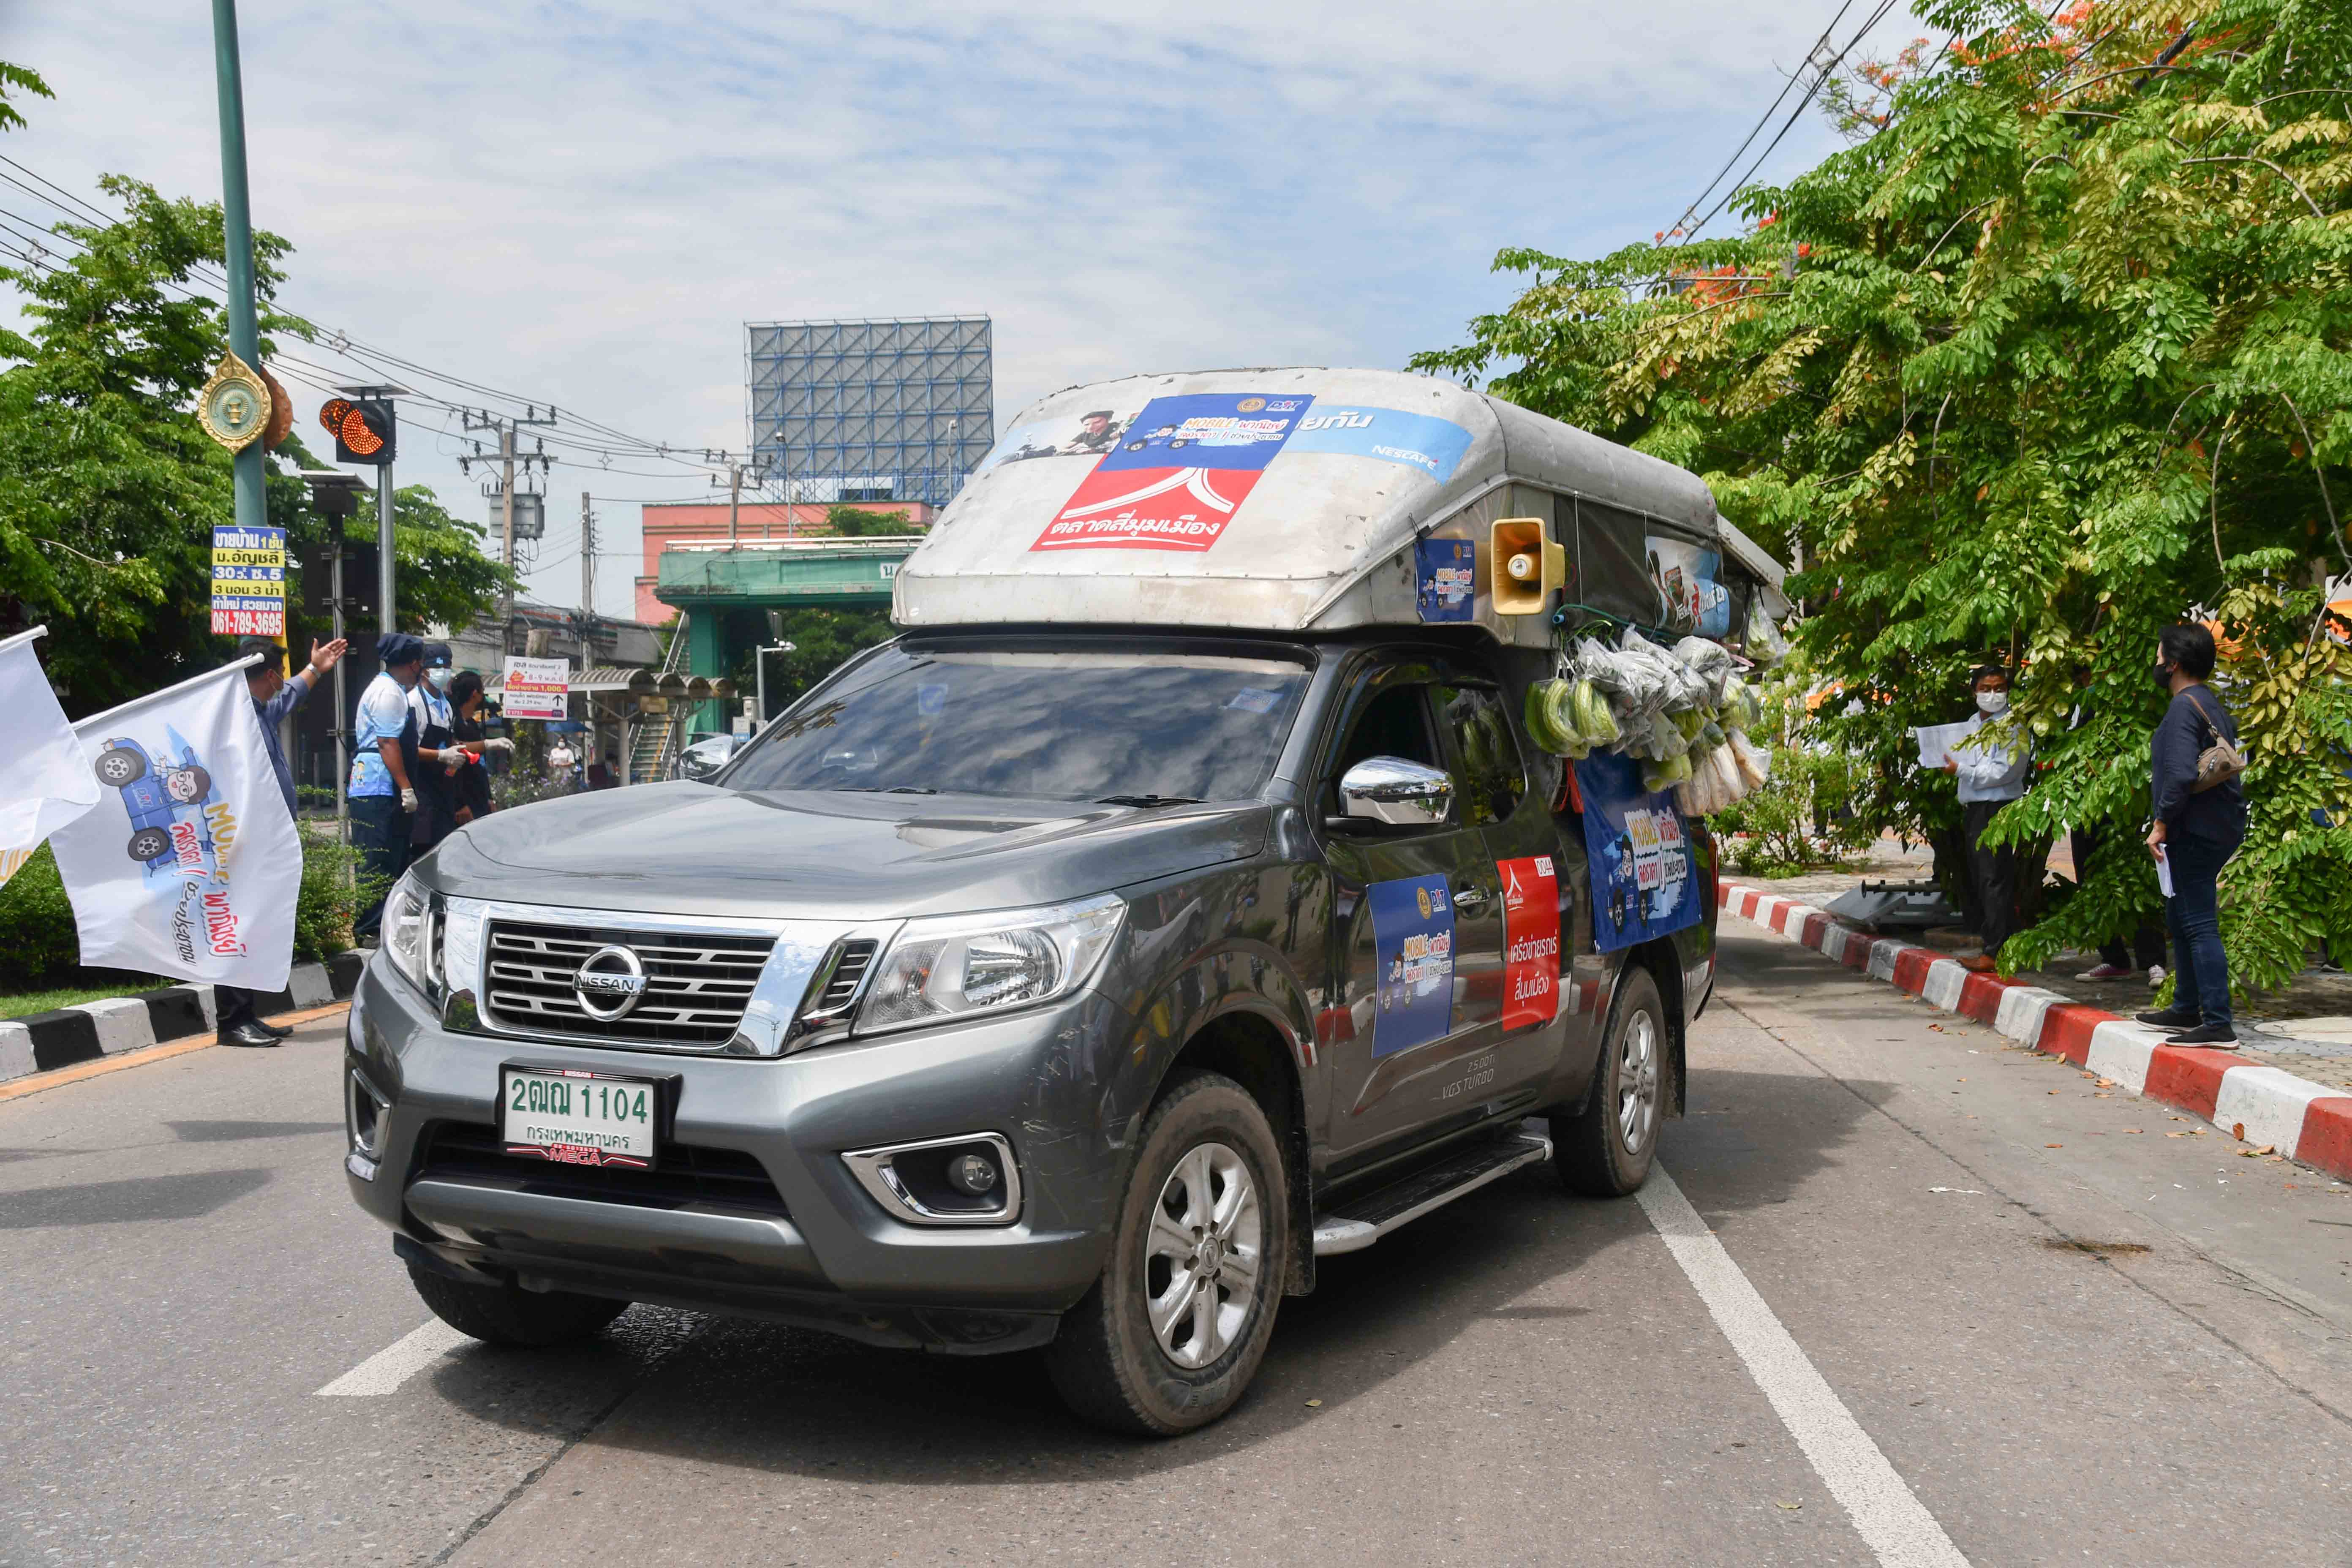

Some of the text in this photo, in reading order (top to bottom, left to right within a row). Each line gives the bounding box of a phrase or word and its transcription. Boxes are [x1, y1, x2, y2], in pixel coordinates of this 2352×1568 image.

[1183, 418, 1237, 428] MOBILE
[1051, 509, 1220, 536] ตลาดสี่มุมเมือง
[215, 528, 283, 549] ขายบ้าน 1 ชั้น
[270, 568, 281, 580] 5
[1437, 569, 1455, 581] MOBILE
[215, 585, 222, 593] 3
[226, 586, 249, 594] นอน
[253, 586, 261, 595] 3
[242, 599, 282, 611] สวยมาก
[213, 611, 282, 635] 061-789-3695
[1627, 814, 1659, 848] MOBILE
[1405, 934, 1428, 960] MOBILE
[579, 976, 634, 990] NISSAN
[1515, 969, 1549, 1007] สี่มุมเมือง
[564, 1070, 591, 1078] NISSAN
[1464, 1068, 1494, 1092] TURBO
[581, 1084, 648, 1124] 1104
[527, 1125, 629, 1149] กรุงเทพมหานคร
[549, 1148, 602, 1166] MEGA
